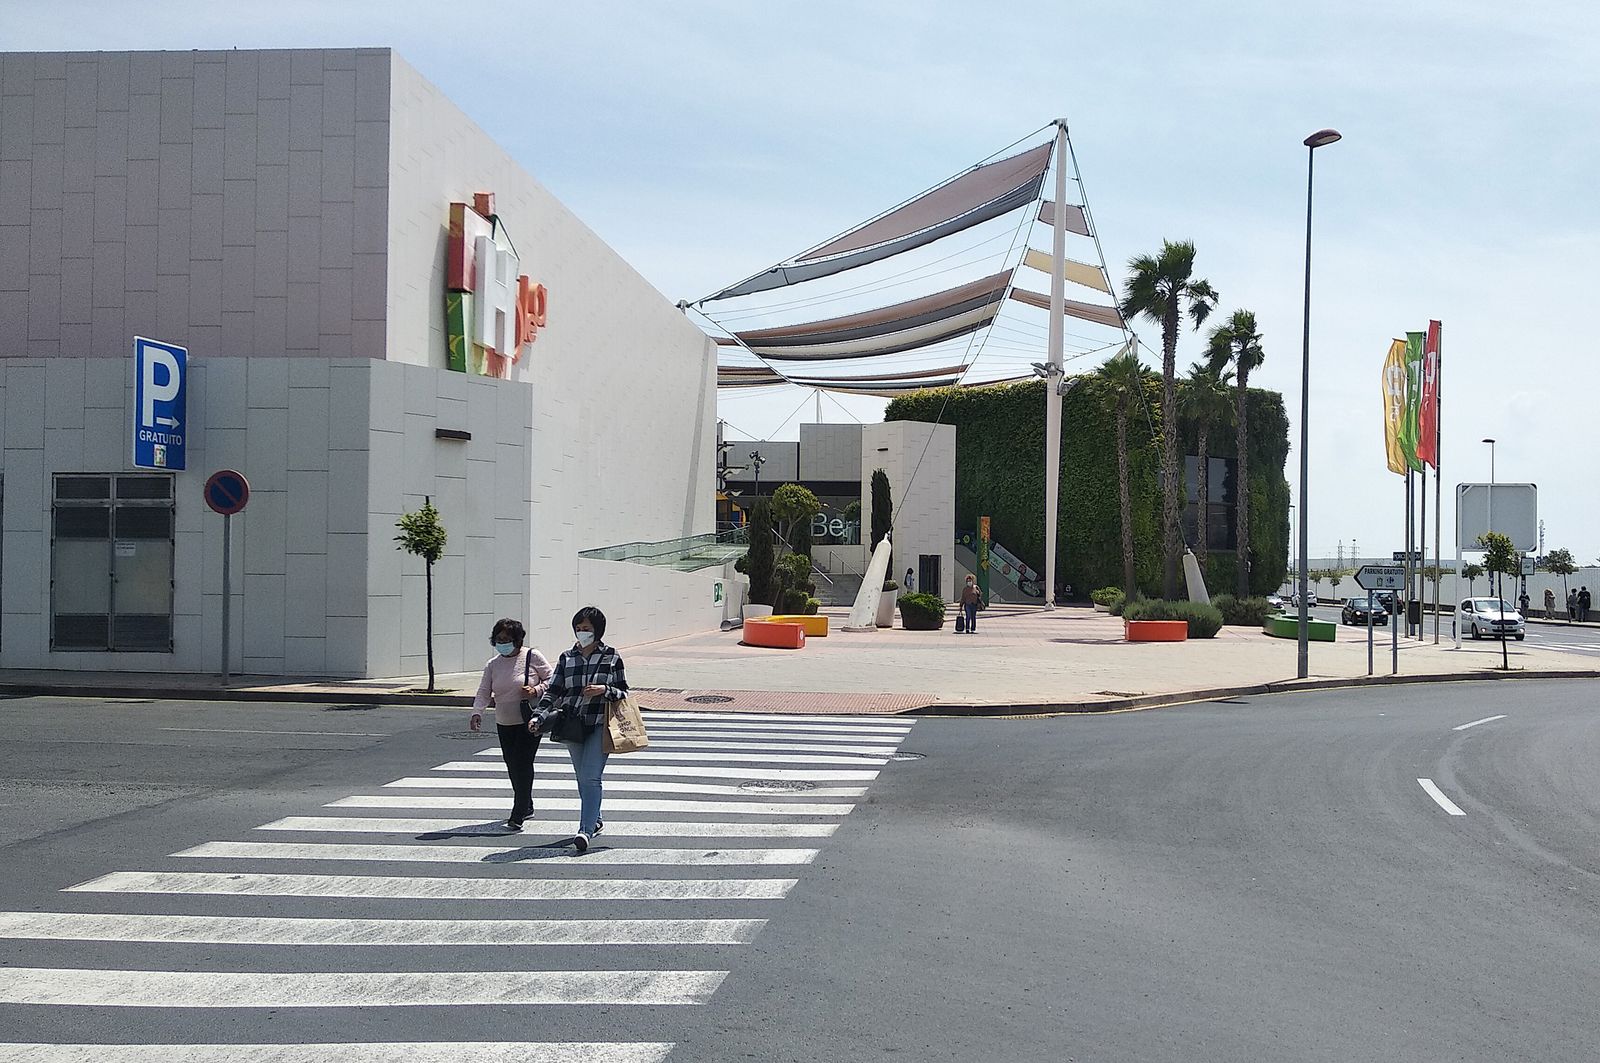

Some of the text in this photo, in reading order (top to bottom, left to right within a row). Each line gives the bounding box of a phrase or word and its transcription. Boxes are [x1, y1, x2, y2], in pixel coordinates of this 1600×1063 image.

[142, 345, 180, 428] P
[139, 429, 183, 446] GRATUITO
[1364, 567, 1404, 576] PARKING GRATUITO
